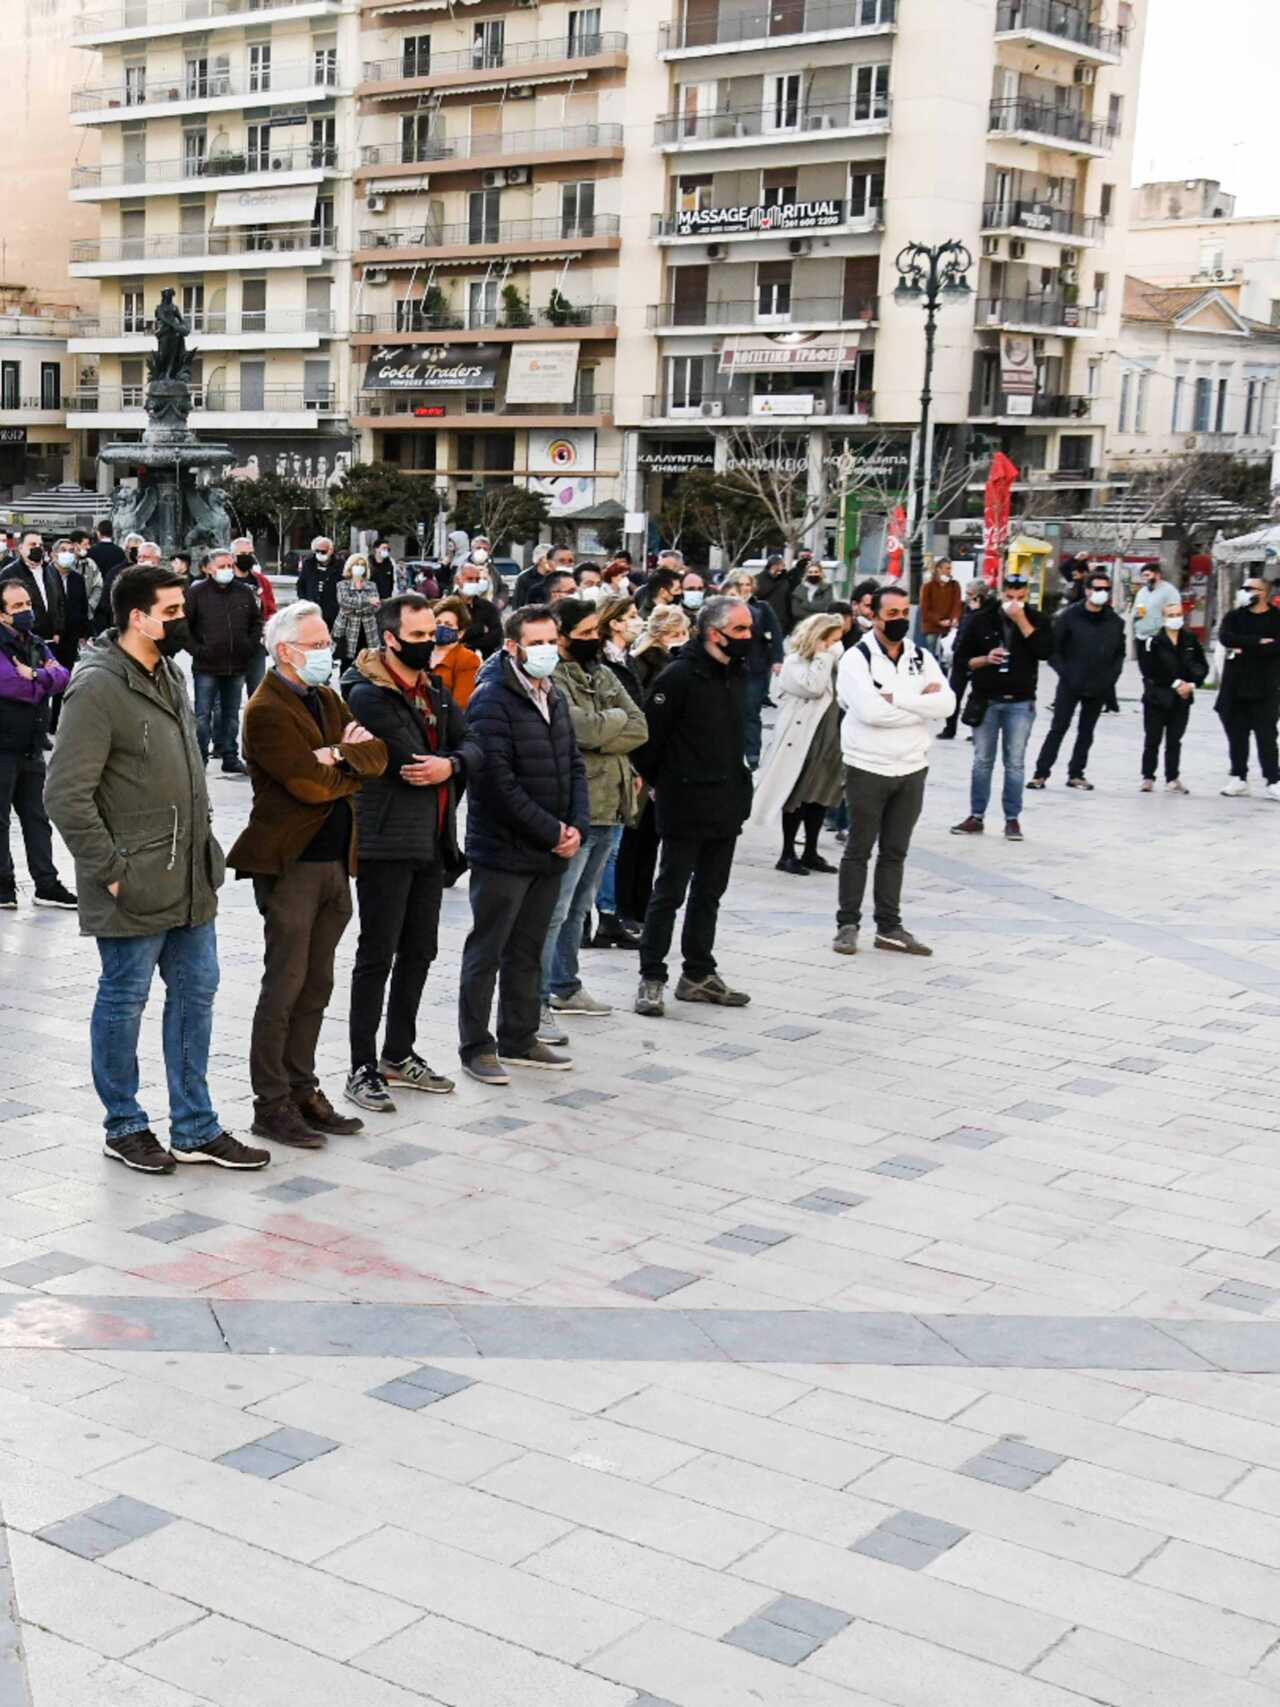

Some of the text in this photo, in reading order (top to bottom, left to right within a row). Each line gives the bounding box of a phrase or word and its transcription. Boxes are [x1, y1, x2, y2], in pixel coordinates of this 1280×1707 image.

[678, 201, 839, 225] MASSAGE RITUAL
[794, 347, 847, 362] ΓΡΑΦΕΙΟ
[378, 361, 483, 379] Gold Traders
[638, 454, 714, 464] ΚΑΛΛΥΝΤΙΚΑ
